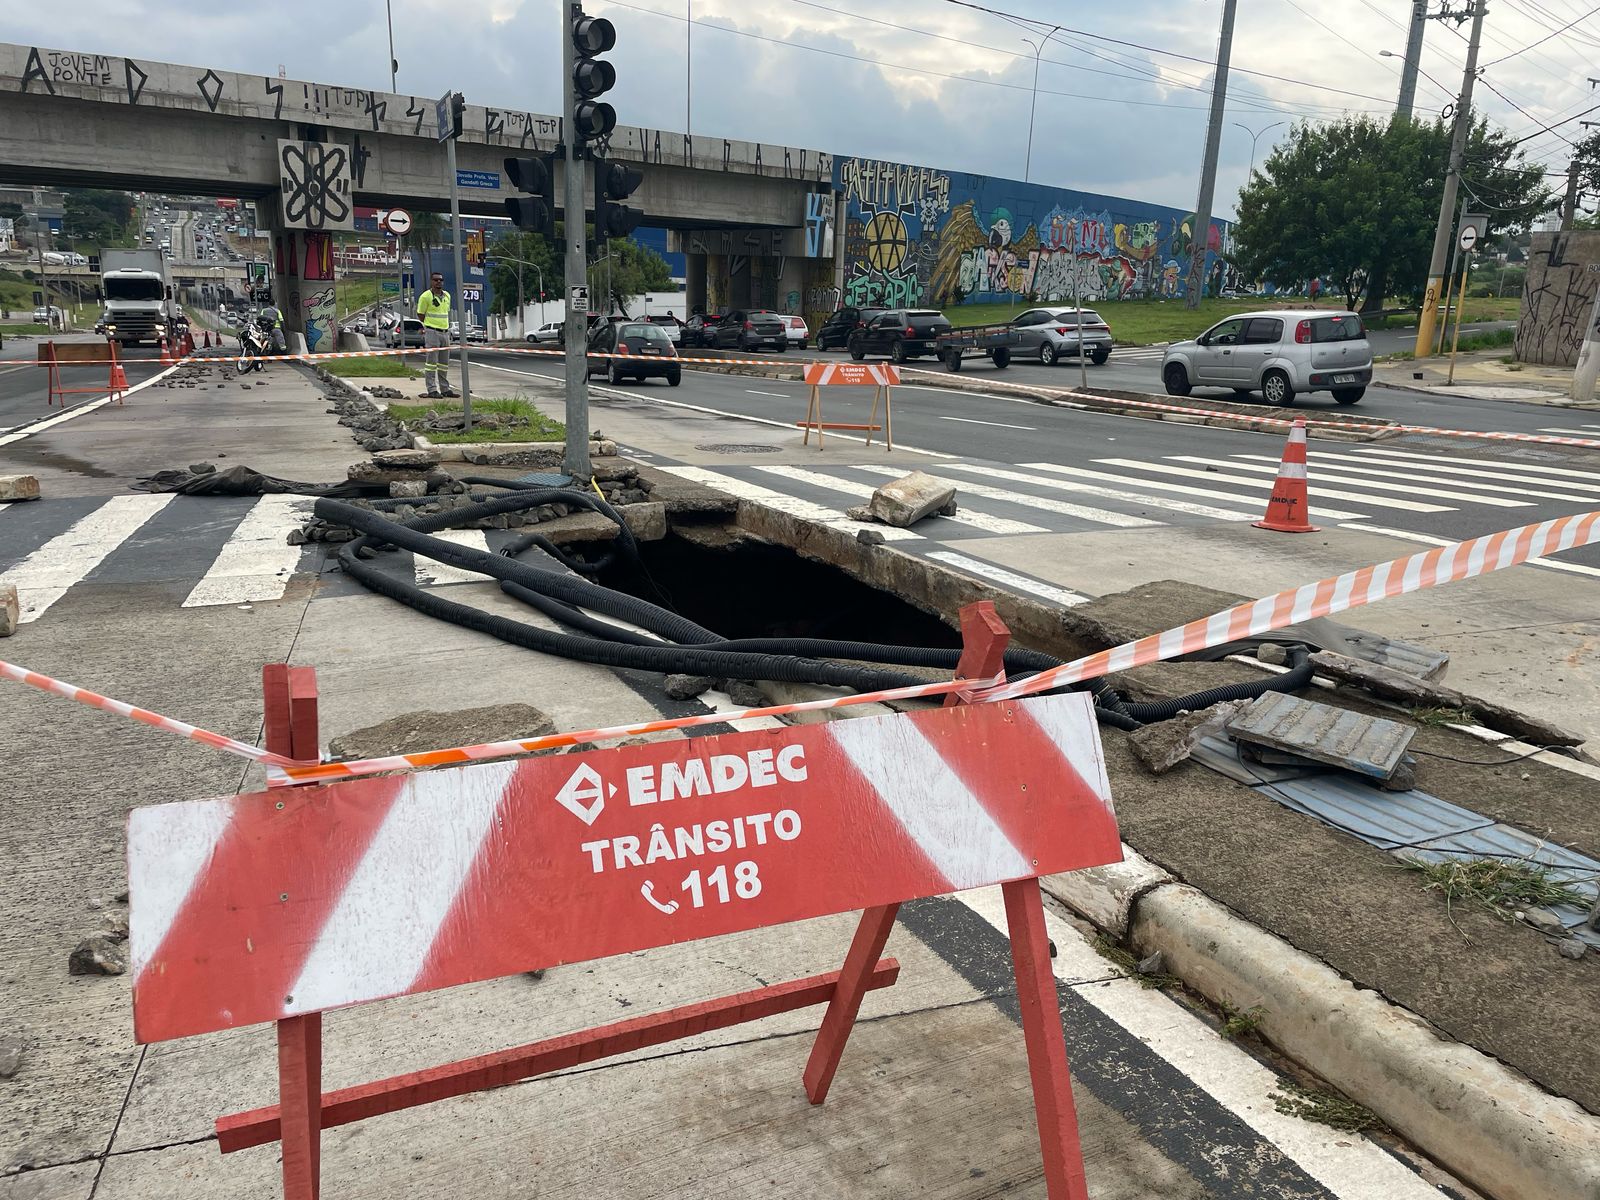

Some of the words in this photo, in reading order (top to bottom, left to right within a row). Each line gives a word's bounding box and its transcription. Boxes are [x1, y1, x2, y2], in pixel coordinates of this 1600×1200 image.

[48, 53, 110, 71] JOVEM
[54, 67, 111, 86] PONTE
[626, 744, 808, 807] EMDEC
[581, 809, 802, 873] TRÂNSITO
[681, 860, 762, 908] 118
